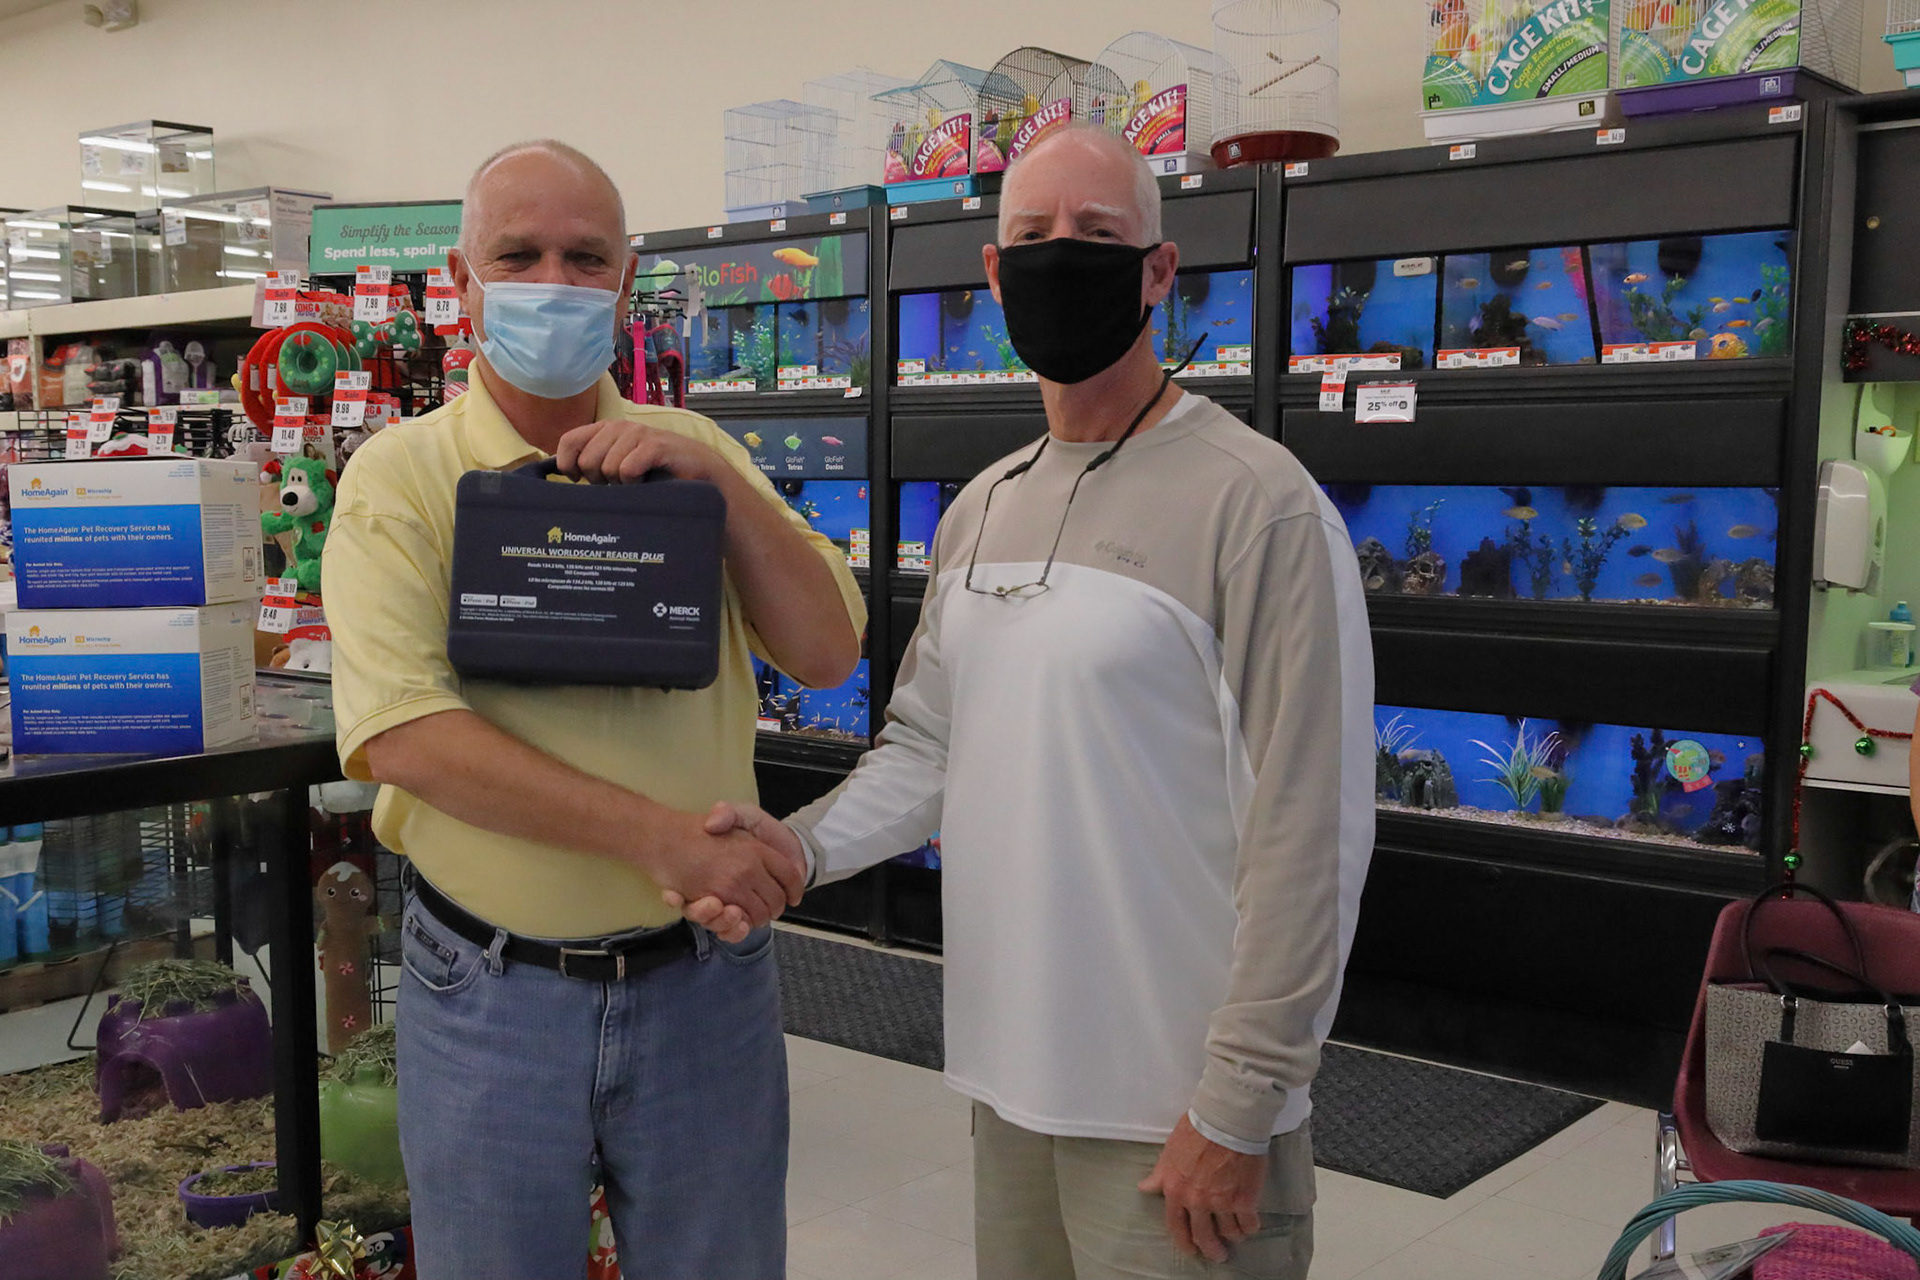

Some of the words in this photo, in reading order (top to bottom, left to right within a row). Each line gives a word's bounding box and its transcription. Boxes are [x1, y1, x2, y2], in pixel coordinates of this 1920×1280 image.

[1681, 2, 1739, 75] CAGE
[1741, 22, 1793, 71] SMALL/MEDIUM
[1488, 24, 1543, 96] CAGE
[1541, 45, 1600, 93] SMALL/MEDIUM
[1513, 63, 1534, 89] Cage
[1033, 102, 1064, 130] KIT!
[1124, 109, 1151, 145] AGE
[1148, 88, 1179, 117] KIT!
[913, 134, 940, 176] CAGE
[936, 117, 963, 143] KIT!
[340, 223, 390, 243] Simplify
[393, 223, 412, 236] the
[415, 222, 460, 236] Season
[324, 246, 367, 261] Spend
[369, 244, 400, 258] less,
[403, 243, 436, 259] spoil
[366, 285, 381, 294] Sale
[437, 288, 452, 296] Sale
[436, 300, 450, 312] 6.78
[335, 403, 350, 414] 8.98
[761, 463, 776, 471] Tetras
[787, 463, 804, 471] Tetras
[21, 488, 68, 498] HomeAgain
[24, 526, 36, 534] The
[38, 526, 78, 535] HomeAgain
[81, 525, 94, 534] Pet
[95, 525, 128, 534] Recovery
[129, 524, 156, 532] Service
[157, 524, 170, 532] has
[24, 535, 53, 544] reunited
[54, 535, 83, 543] millions
[93, 535, 109, 543] pets
[111, 534, 126, 542] with
[501, 546, 548, 555] UNIVERSAL
[606, 551, 639, 560] READER
[669, 606, 700, 616] MERCK
[19, 635, 67, 645] HomeAgain
[35, 674, 76, 682] HomeAgain
[93, 673, 126, 681] Recovery
[156, 672, 169, 680] has
[126, 681, 142, 689] their
[144, 681, 173, 689] owners.
